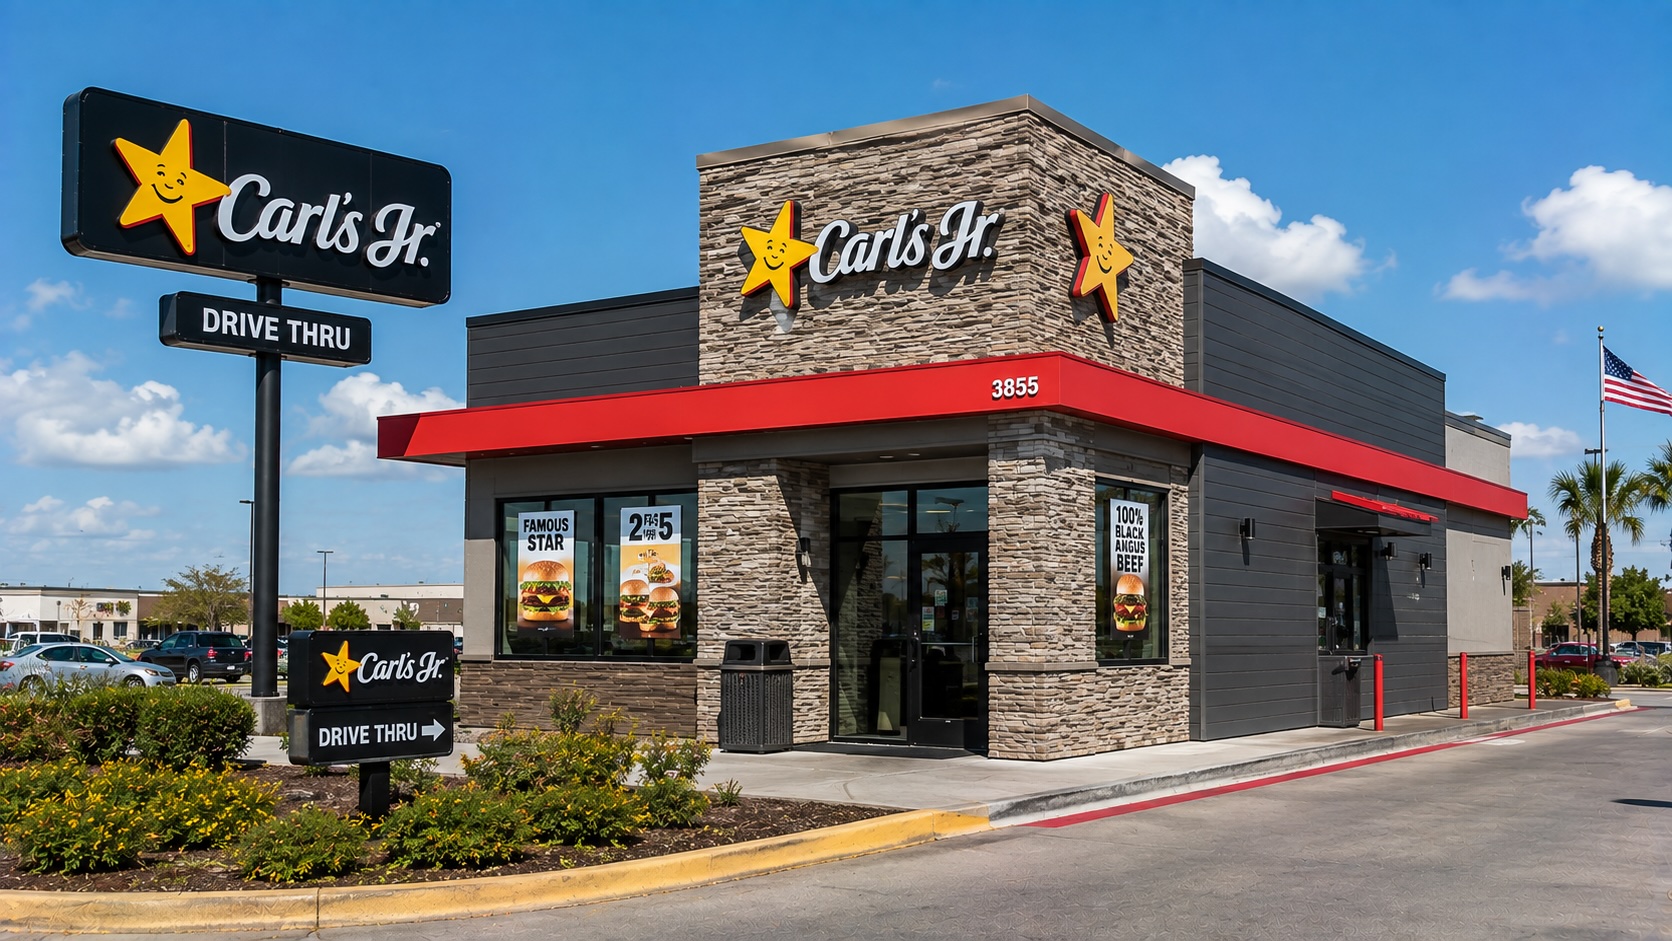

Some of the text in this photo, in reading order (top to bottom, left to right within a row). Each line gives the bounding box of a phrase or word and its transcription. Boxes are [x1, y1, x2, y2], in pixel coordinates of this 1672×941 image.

[217, 173, 437, 268] Carl's Jr.
[809, 199, 1001, 284] Carl's Jr.
[202, 307, 351, 349] DRIVE THRU
[991, 375, 1039, 399] 3855
[523, 517, 569, 533] FAMOUS
[629, 513, 643, 541] 2
[659, 512, 673, 540] 5
[1116, 505, 1143, 526] 100%
[527, 533, 564, 551] STAR
[1115, 525, 1144, 539] BLACK
[1115, 539, 1145, 554] ANGUS
[1116, 553, 1144, 573] BEEF
[357, 651, 444, 684] Carl's Jr.
[319, 722, 416, 747] DRIVE THRU
